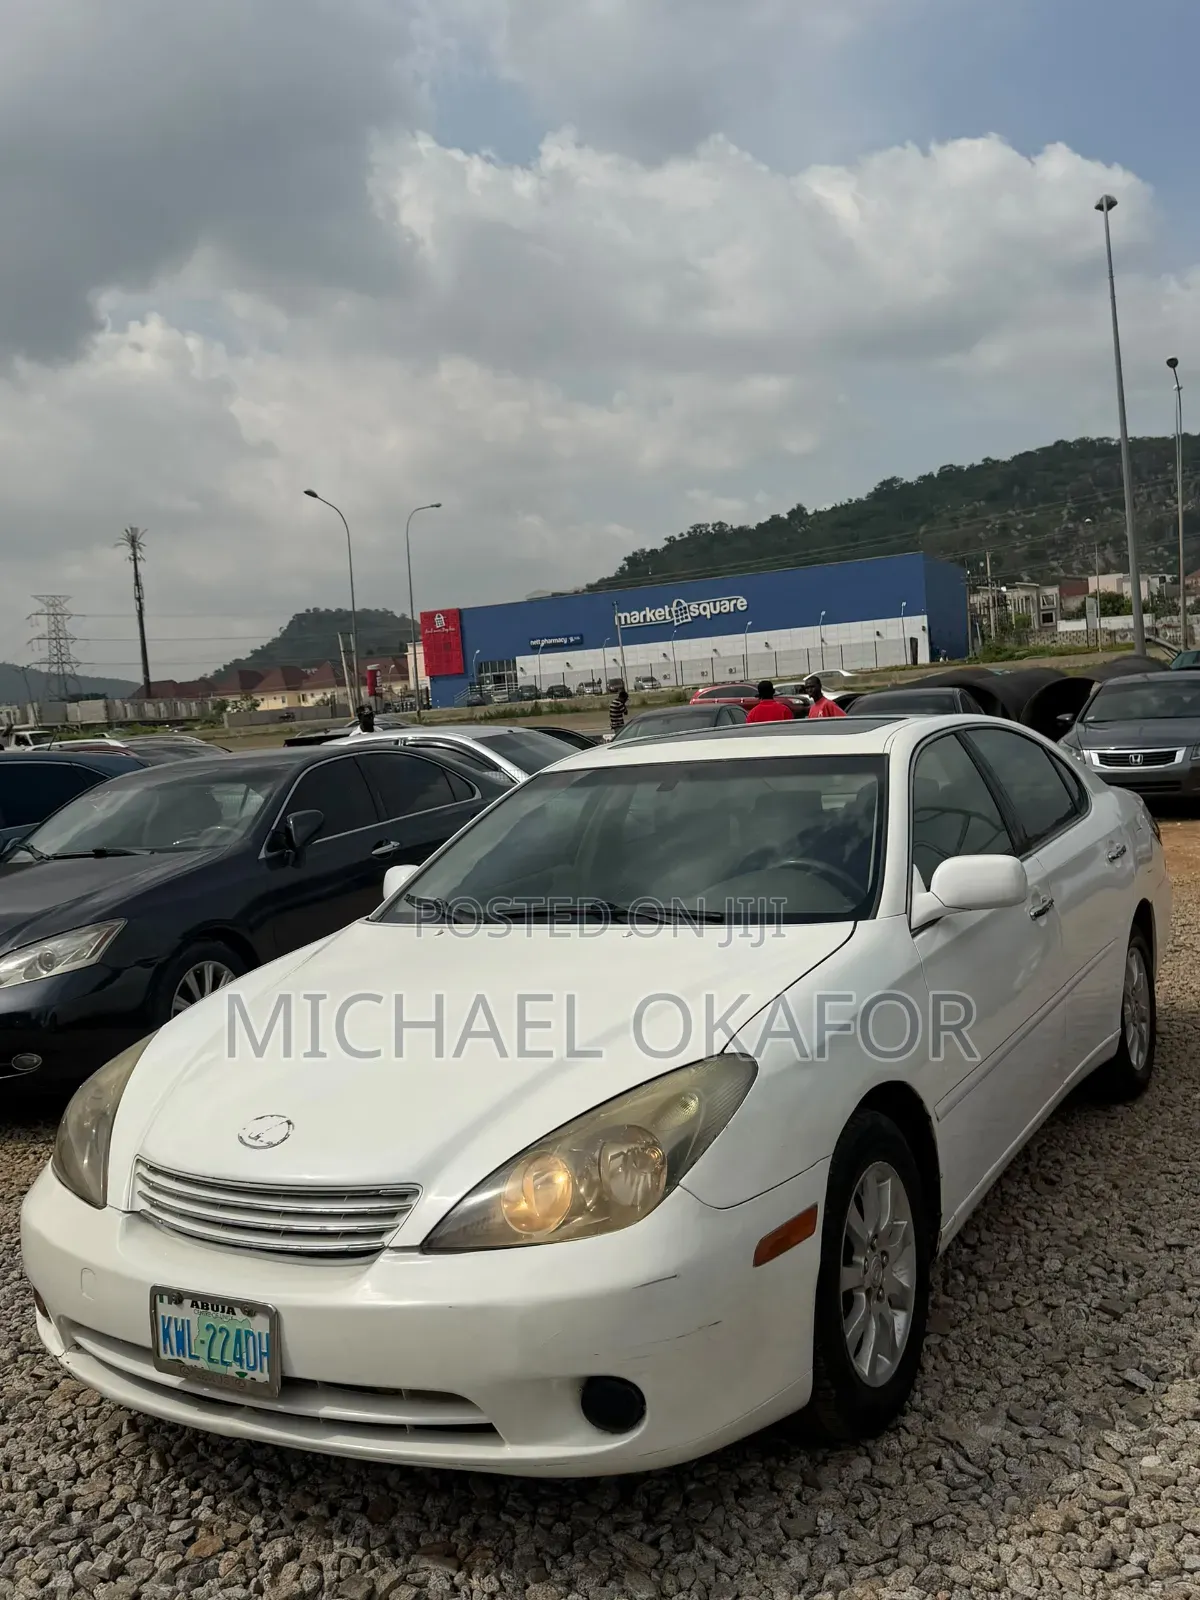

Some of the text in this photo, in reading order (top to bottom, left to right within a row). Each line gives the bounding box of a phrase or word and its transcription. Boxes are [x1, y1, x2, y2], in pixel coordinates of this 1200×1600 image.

[615, 598, 748, 625] market square
[541, 637, 568, 645] pharmacy
[190, 1300, 237, 1316] ABUJA
[161, 1314, 270, 1375] KWL-224DH
